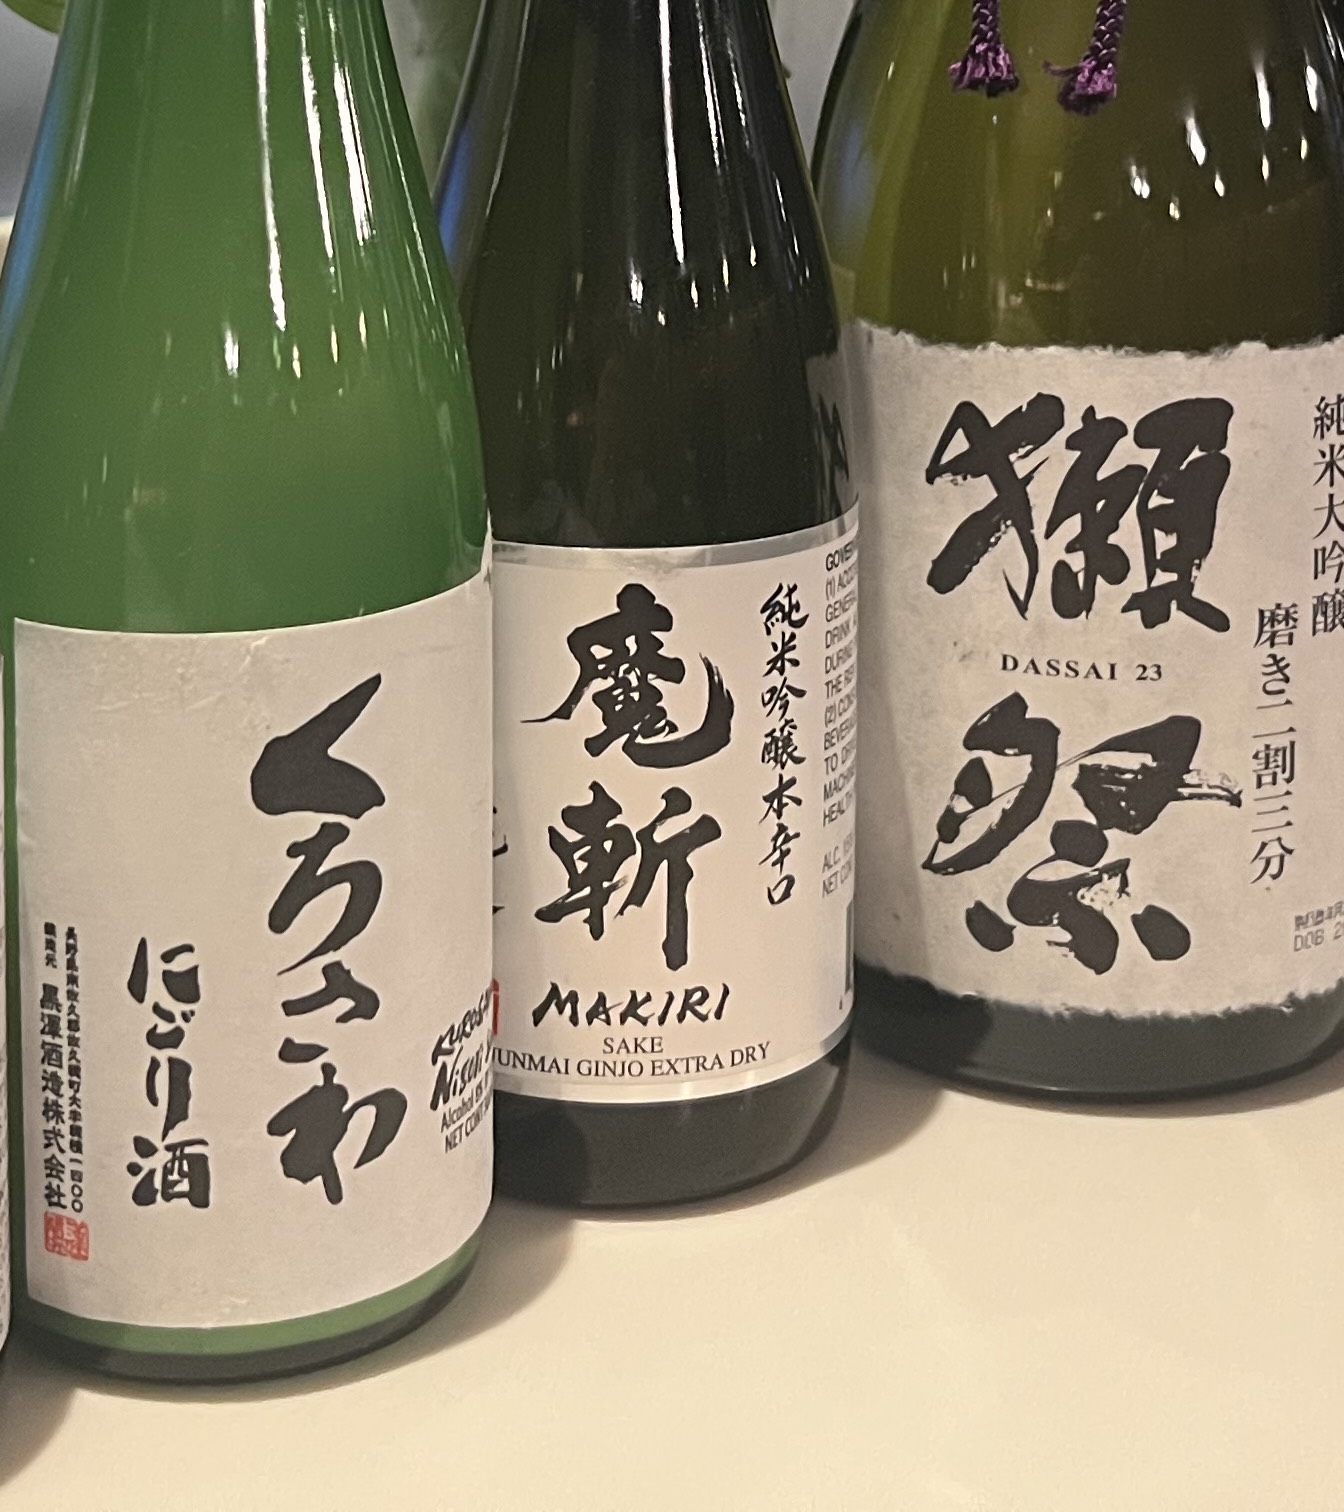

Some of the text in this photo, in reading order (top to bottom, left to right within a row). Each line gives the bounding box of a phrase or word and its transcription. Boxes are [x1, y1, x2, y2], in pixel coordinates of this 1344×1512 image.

[824, 673, 842, 700] THE
[922, 392, 1242, 975] 獺祭
[1000, 652, 1164, 683] DASSAI 23
[758, 582, 809, 906] 純米吟醸本辛口
[823, 752, 838, 776] TO
[1250, 600, 1300, 885] 磨き二割三分
[521, 583, 734, 971] 魔斬
[251, 673, 407, 1205] くろさわ
[531, 980, 731, 1027] MAKIRI
[576, 1058, 644, 1077] GINJO
[650, 1055, 724, 1077] EXTRA
[730, 1040, 772, 1068] DRY
[602, 1036, 664, 1055] SAKE
[126, 936, 211, 1209] にごり酒
[440, 1088, 474, 1134] Alcohol
[444, 1122, 464, 1154] NET
